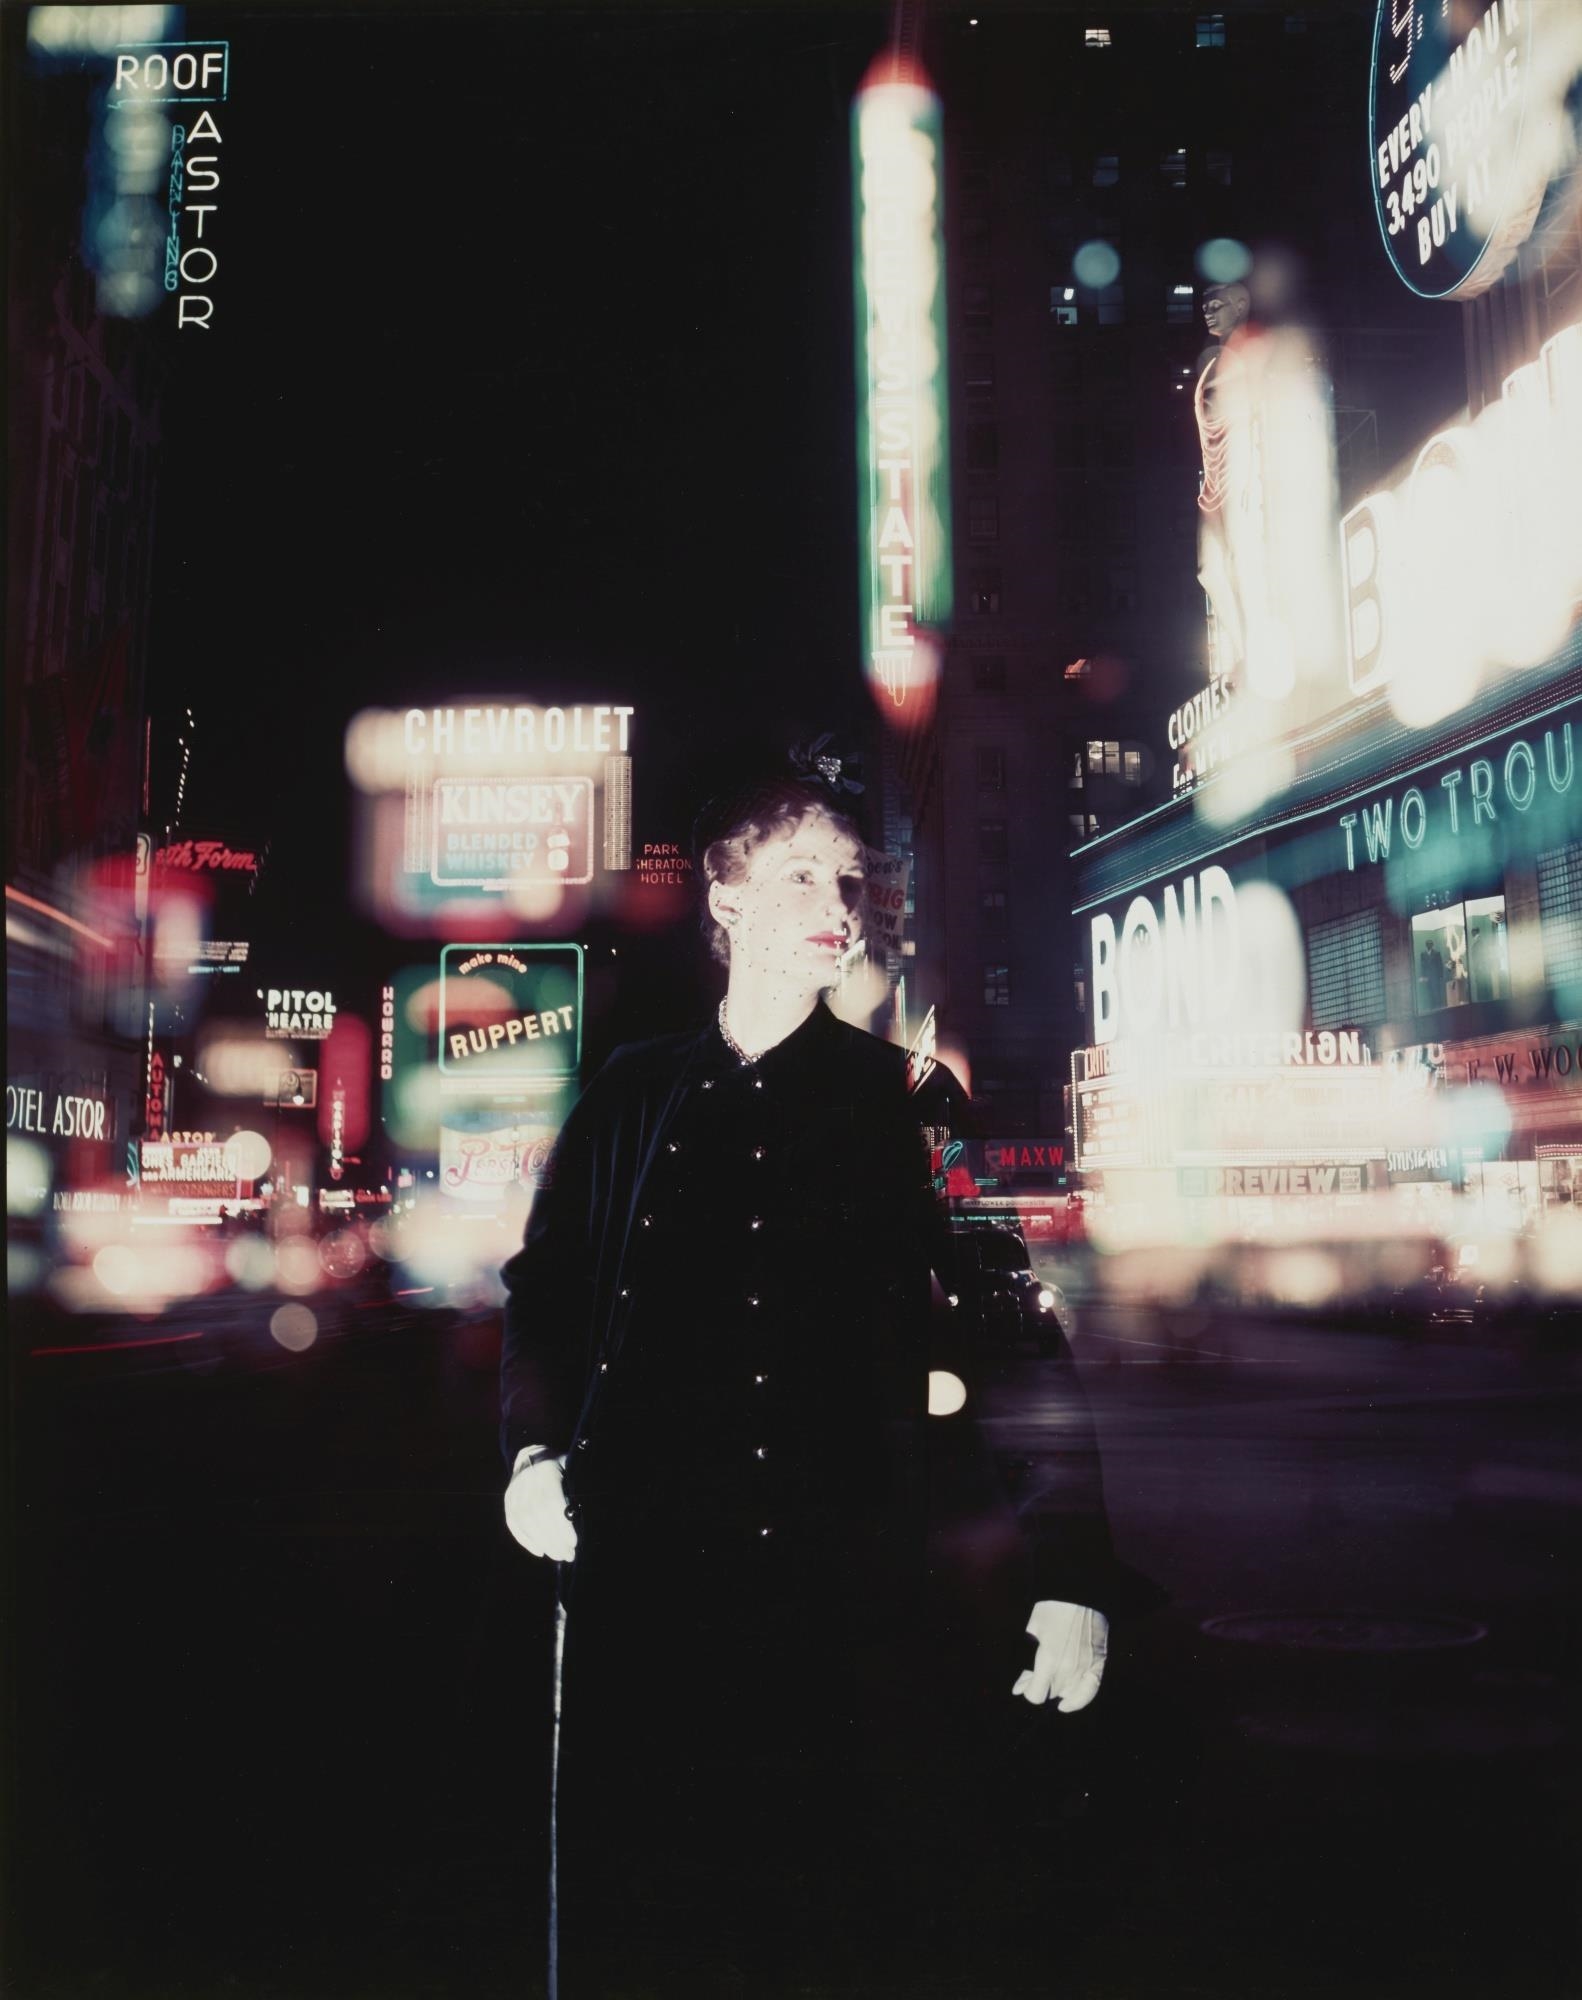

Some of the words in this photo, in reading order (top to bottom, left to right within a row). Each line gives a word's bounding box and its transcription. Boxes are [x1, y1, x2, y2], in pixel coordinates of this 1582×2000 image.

[115, 53, 223, 90] ROOF
[178, 110, 223, 329] ASTOR
[1416, 182, 1457, 265] BUY
[878, 410, 915, 647] STATE
[404, 706, 634, 754] CHEVROLET
[1168, 674, 1230, 750] CLOTHES
[440, 784, 585, 825] KINSEY
[447, 832, 538, 852] BLENDED
[644, 844, 679, 855] PARK
[1340, 788, 1426, 871] TWO
[445, 852, 535, 871] WHISKEY
[641, 872, 684, 884] HOTEL
[869, 882, 904, 910] BIG
[458, 953, 493, 975] make
[496, 954, 528, 974] mine
[1091, 866, 1236, 1046] BOND
[381, 986, 394, 1080] HOWARD
[450, 1005, 573, 1060] RUPPERT
[52, 1094, 106, 1141] ASTOR
[161, 1132, 213, 1145] ASTOR
[999, 1146, 1064, 1167] MAXW
[1217, 1167, 1336, 1195] PREVIEW
